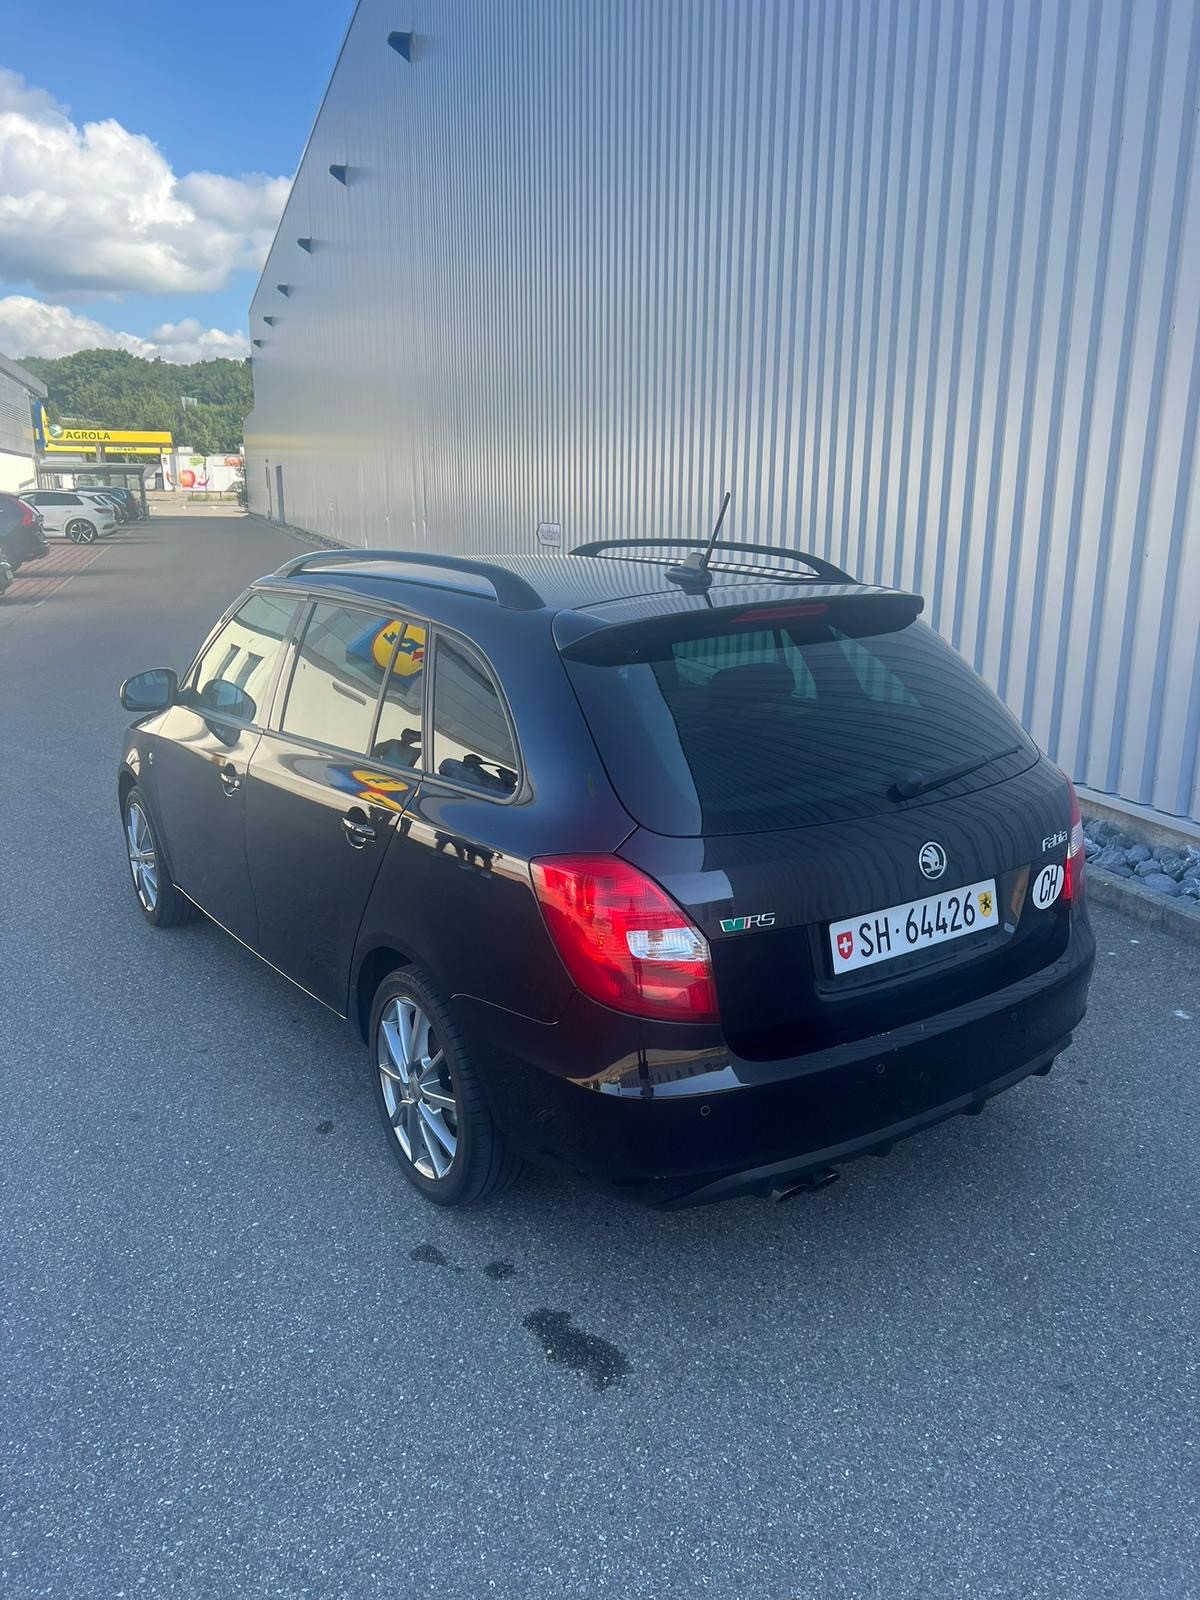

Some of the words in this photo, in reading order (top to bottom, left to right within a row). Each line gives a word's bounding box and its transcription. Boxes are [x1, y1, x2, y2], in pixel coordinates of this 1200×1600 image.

[66, 432, 111, 440] AGROLA
[1042, 831, 1068, 852] Fabia
[1040, 865, 1059, 903] CH
